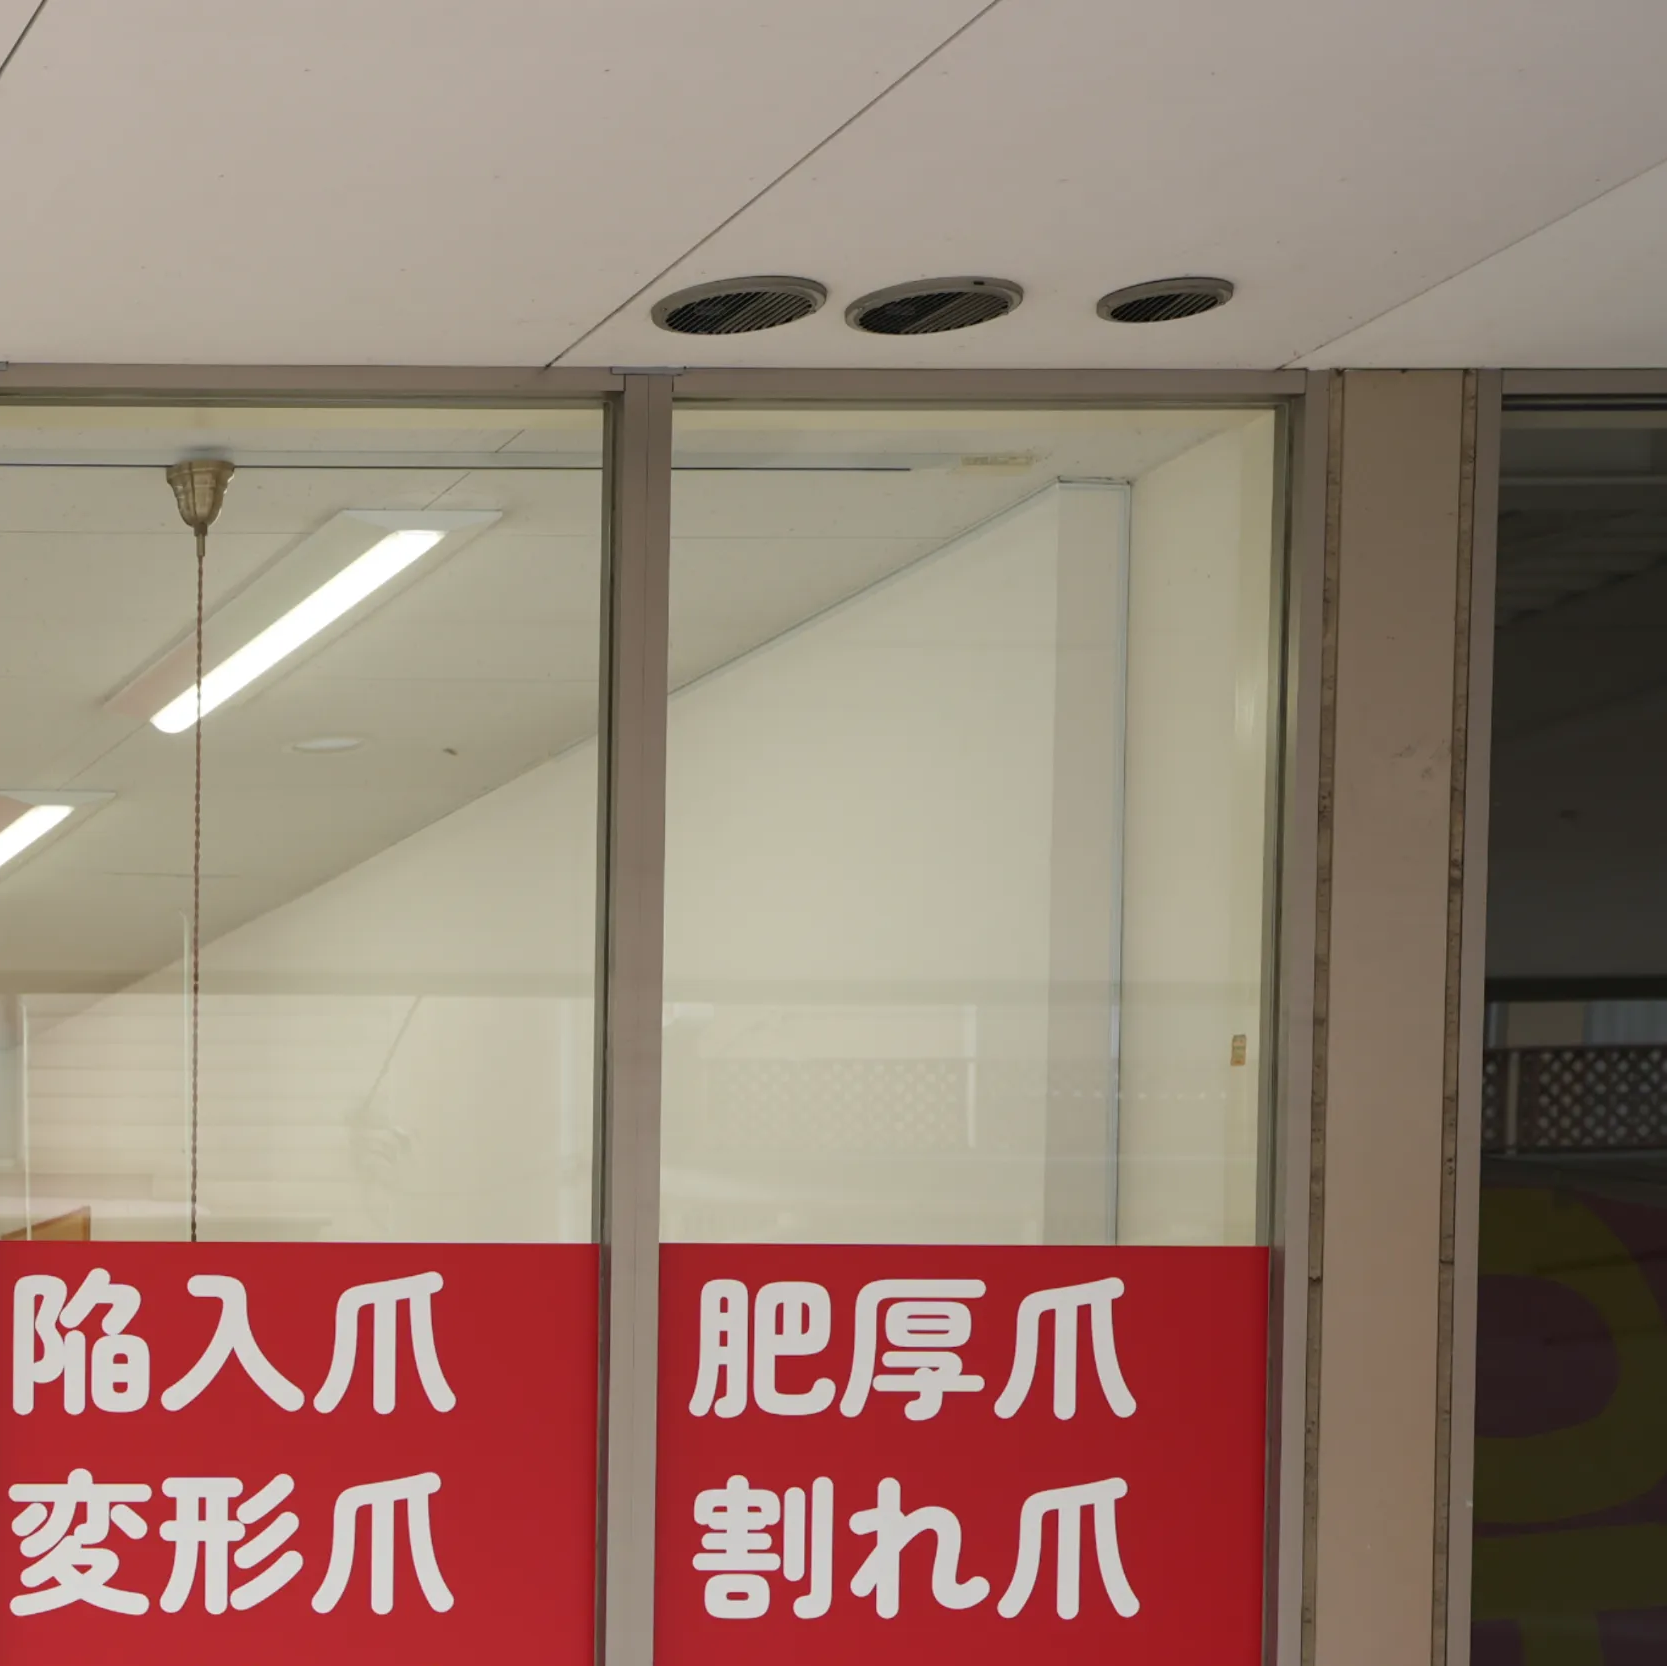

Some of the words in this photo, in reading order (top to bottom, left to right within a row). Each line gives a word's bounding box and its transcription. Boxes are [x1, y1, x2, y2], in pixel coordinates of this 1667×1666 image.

[12, 1267, 457, 1416] 陥入爪
[688, 1277, 1137, 1421] 肥厚爪
[8, 1468, 455, 1617] 変形爪
[692, 1474, 1140, 1620] 割れ爪
